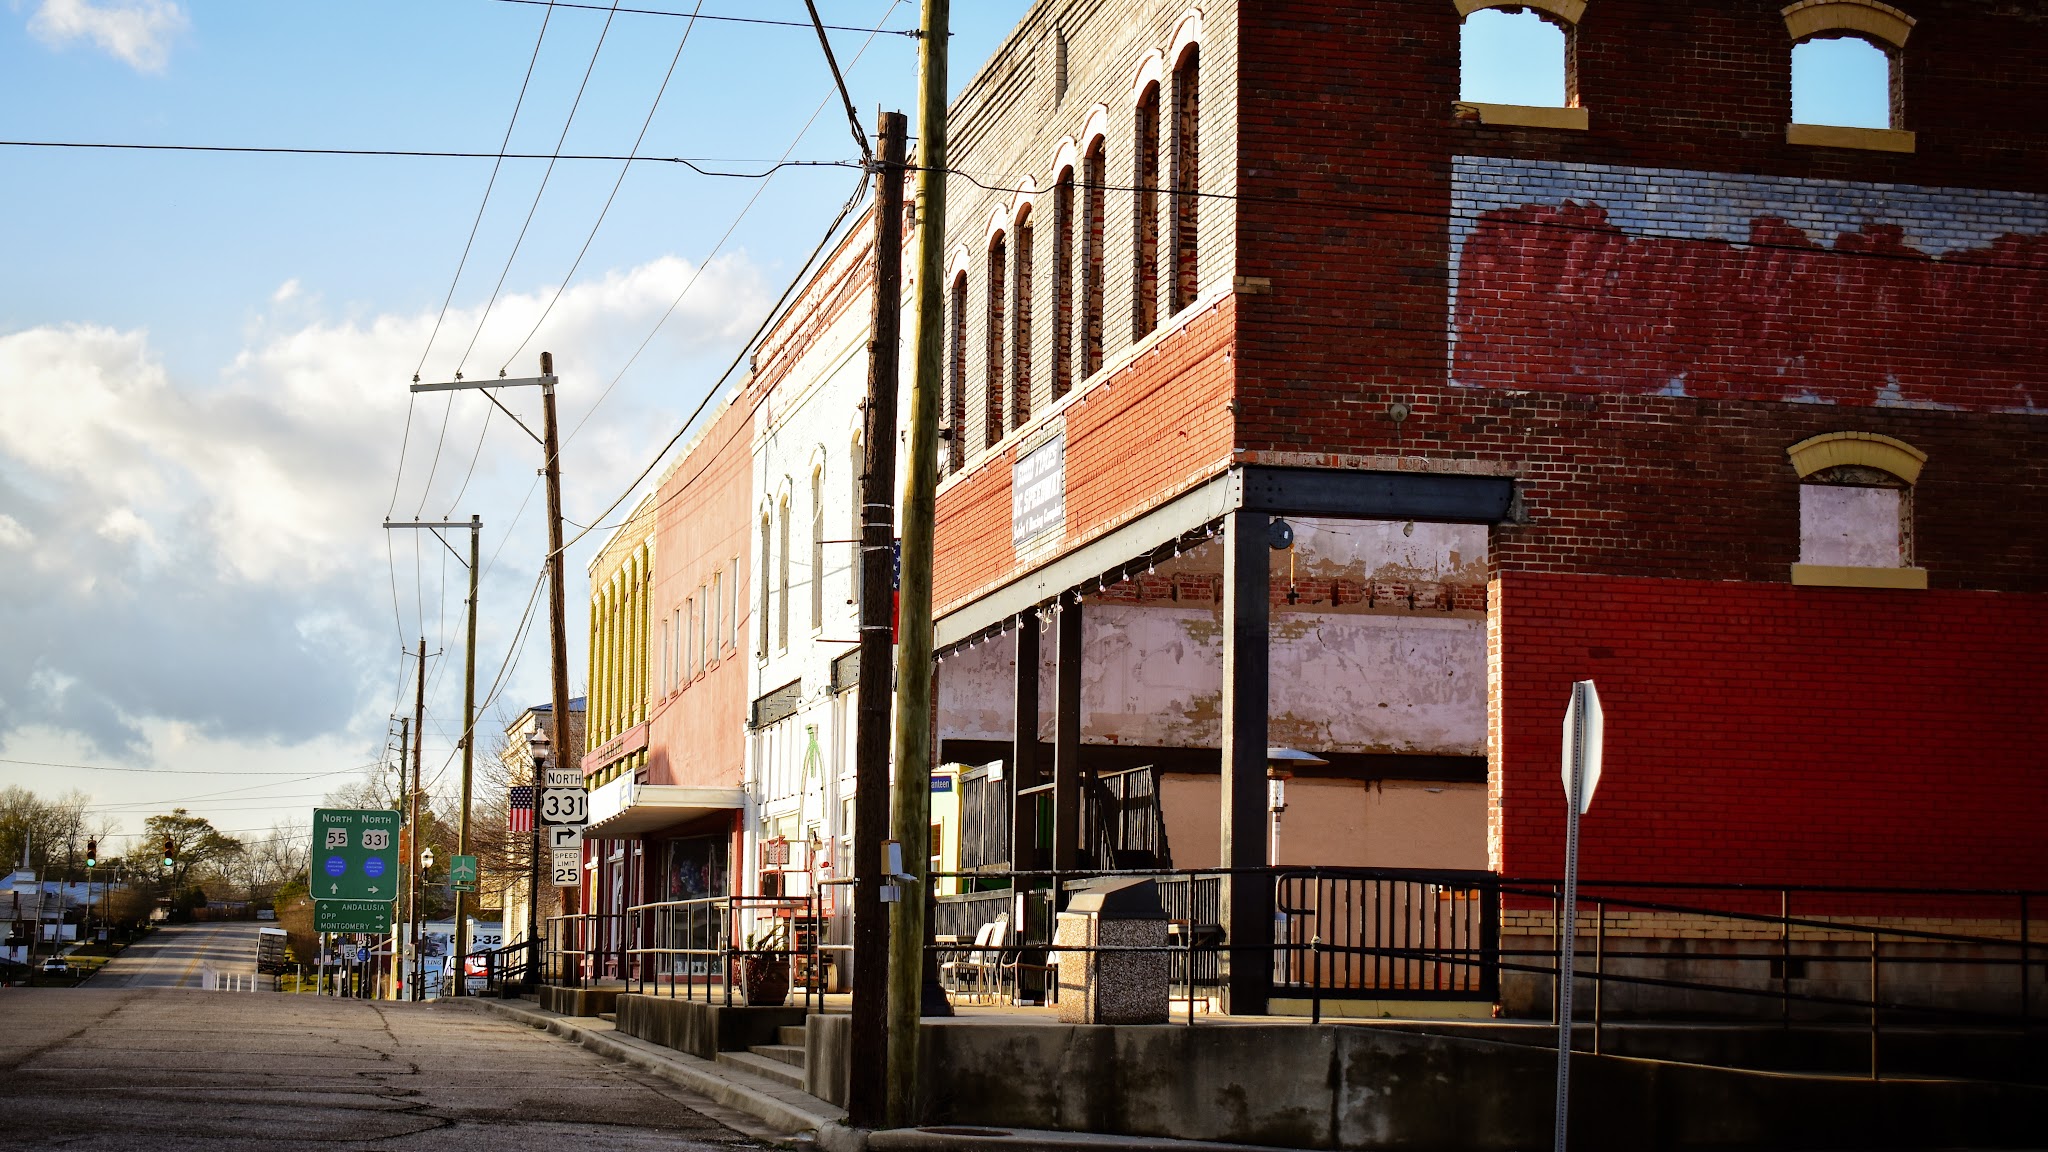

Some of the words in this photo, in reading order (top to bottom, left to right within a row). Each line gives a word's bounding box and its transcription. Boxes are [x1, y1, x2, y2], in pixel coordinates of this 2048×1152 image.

[1034, 442, 1058, 477] TIMES
[549, 773, 581, 784] NORTH
[931, 779, 949, 788] anteen
[546, 796, 583, 816] 331
[323, 814, 352, 823] NORTH
[362, 815, 391, 824] NORTH
[328, 833, 346, 844] 55
[364, 834, 387, 846] 331
[556, 869, 577, 881] 25
